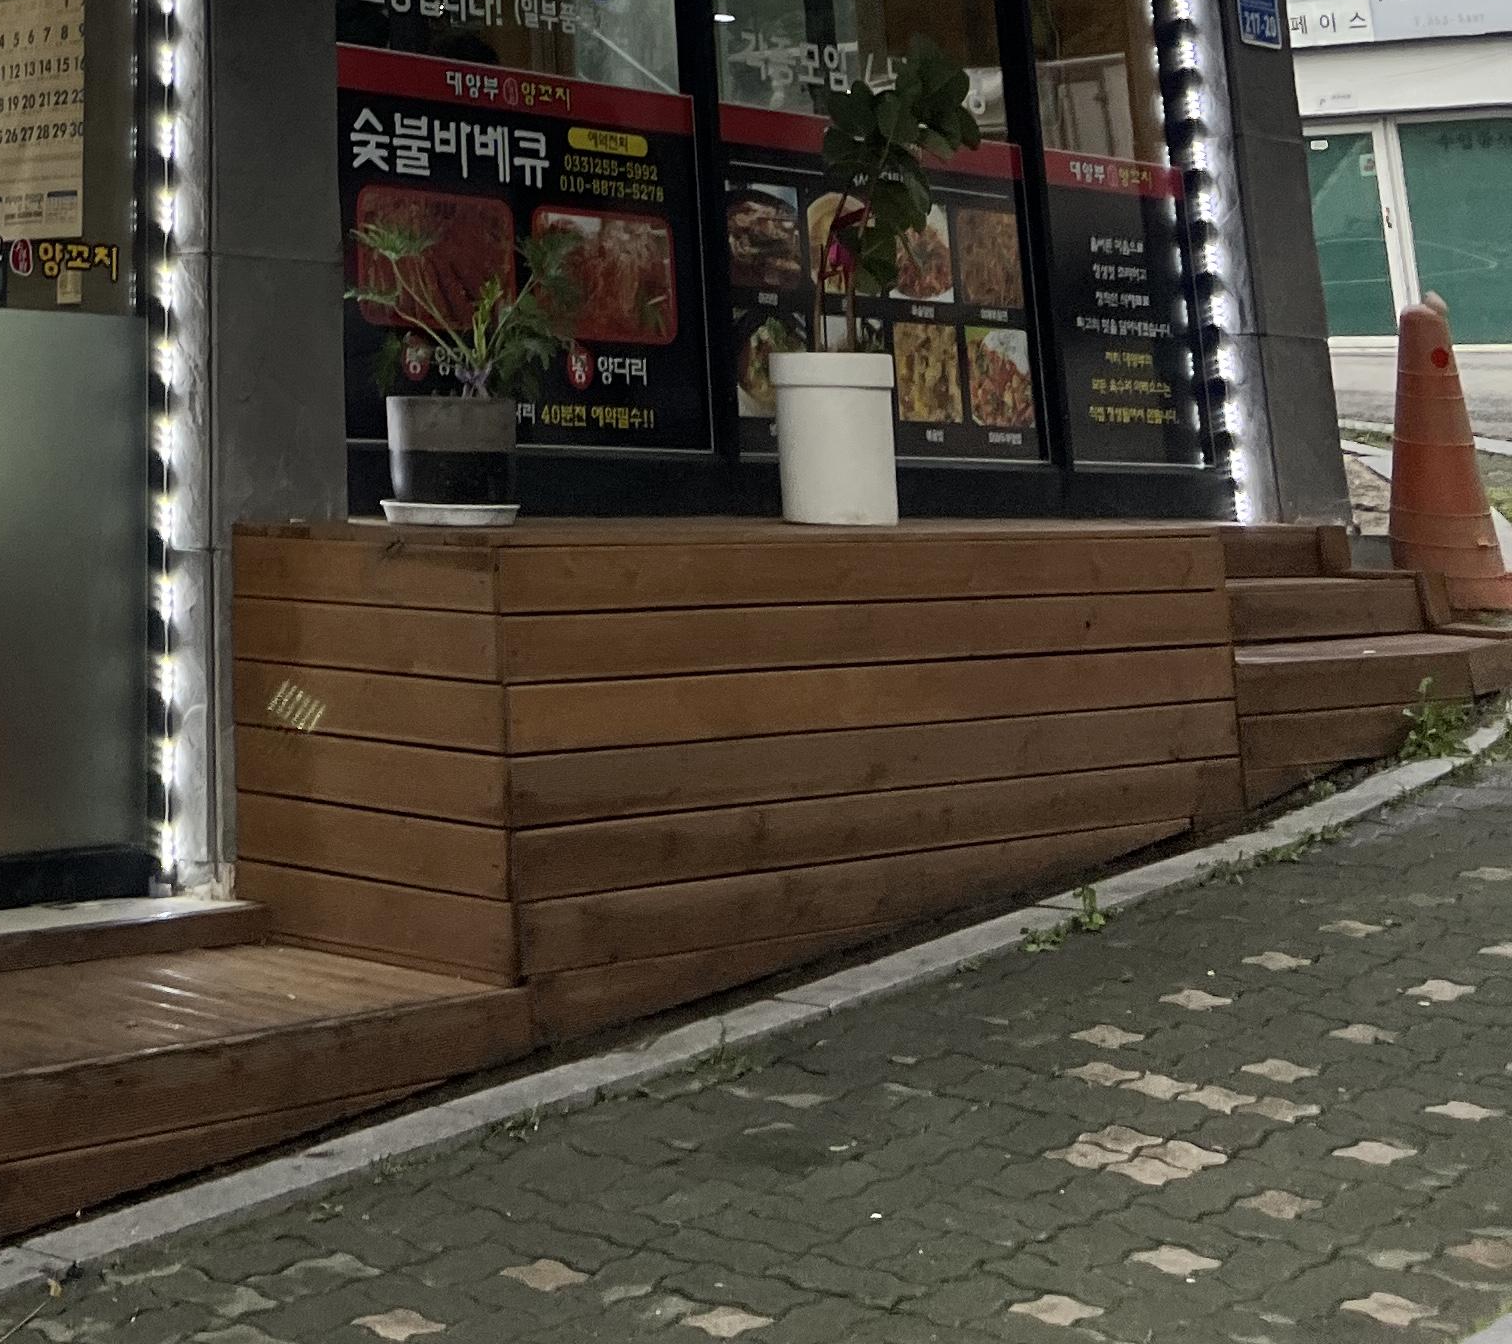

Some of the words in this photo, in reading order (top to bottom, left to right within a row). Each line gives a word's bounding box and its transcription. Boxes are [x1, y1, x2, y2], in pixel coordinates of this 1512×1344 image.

[445, 70, 499, 101] 대양부
[521, 78, 571, 111] 양꼬치
[350, 107, 550, 189] 숯불바베큐
[38, 243, 119, 282] 양꼬치
[597, 355, 648, 386] 양다리
